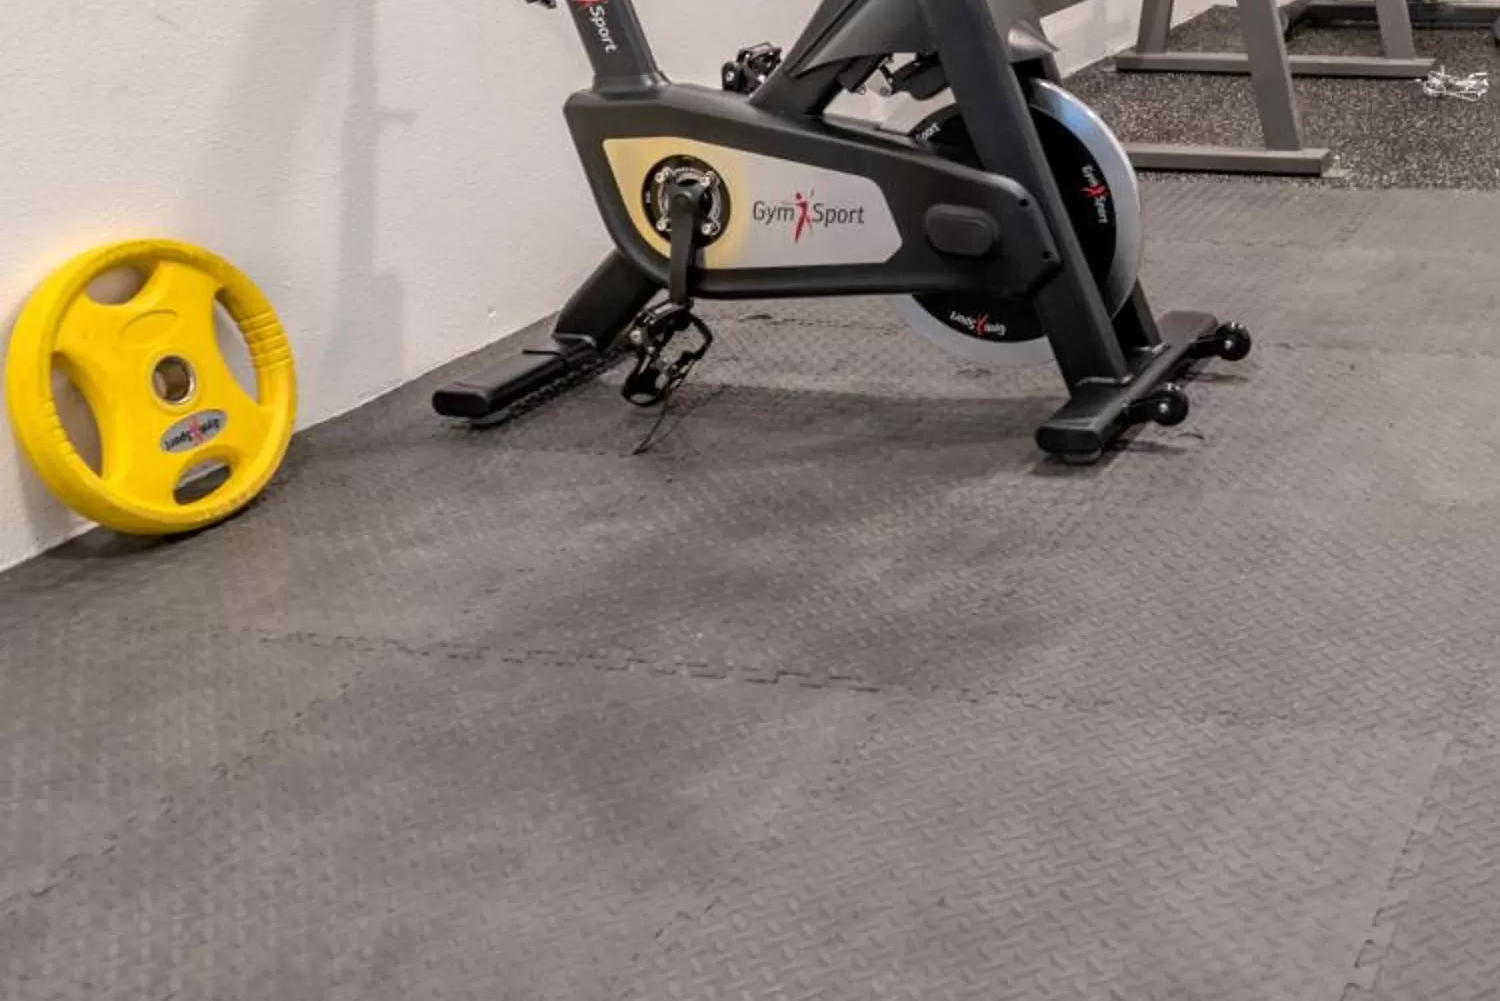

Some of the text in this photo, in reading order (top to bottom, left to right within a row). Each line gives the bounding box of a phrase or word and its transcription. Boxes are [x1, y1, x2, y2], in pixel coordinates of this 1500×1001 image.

[589, 5, 619, 54] Sport
[753, 200, 865, 227] Gym Sport
